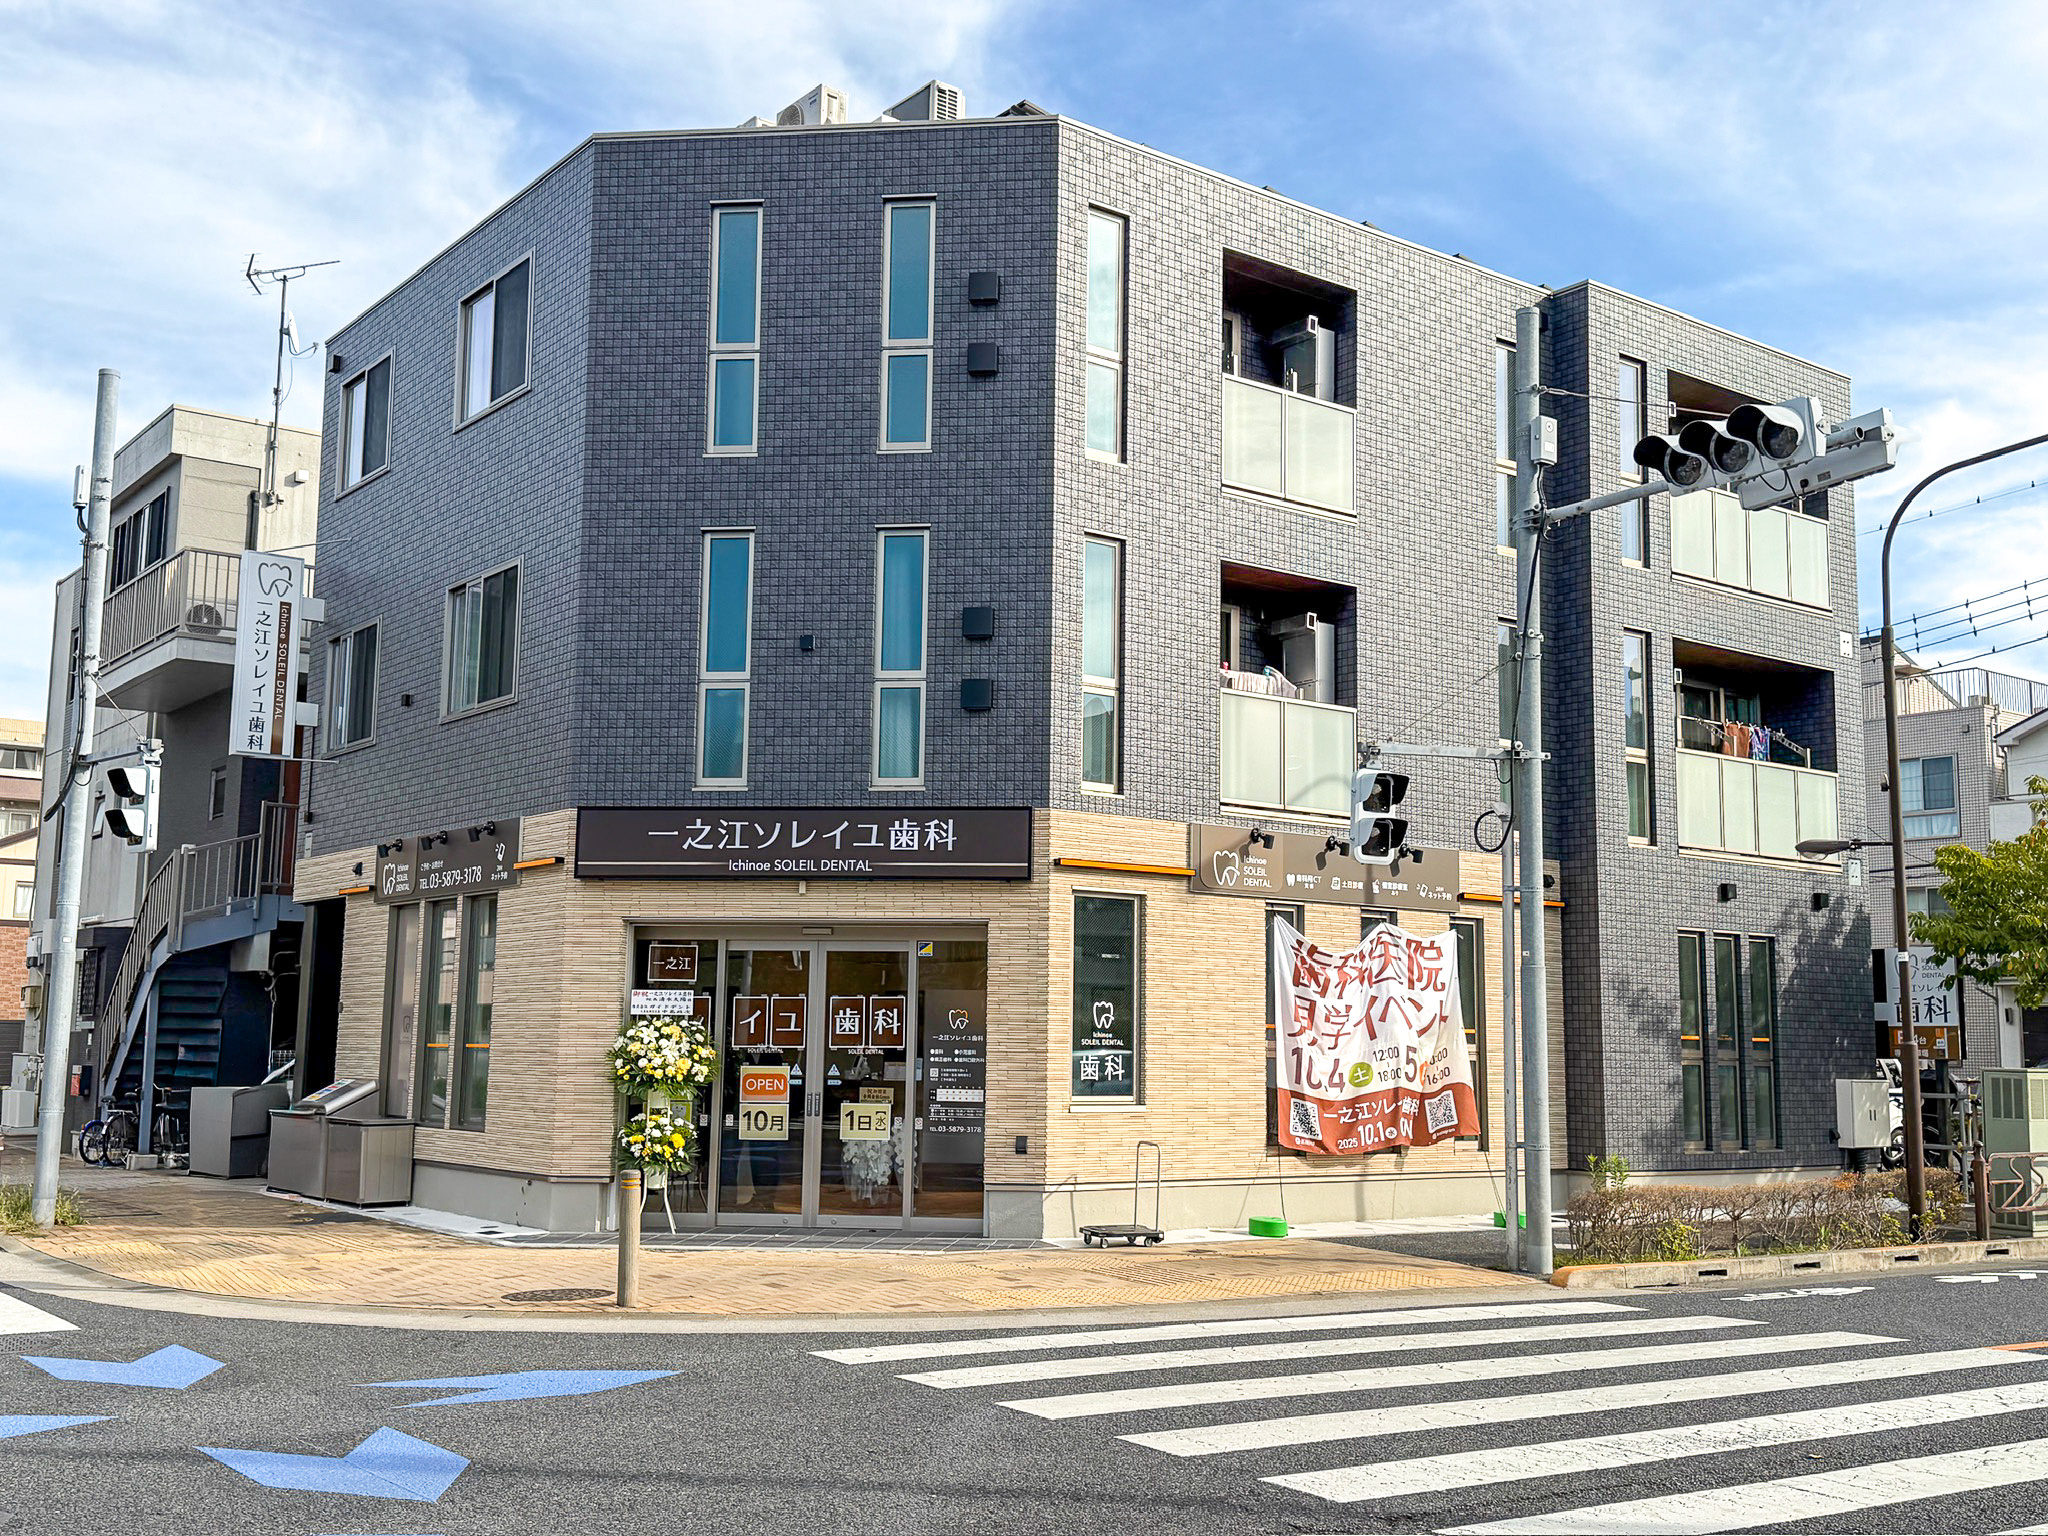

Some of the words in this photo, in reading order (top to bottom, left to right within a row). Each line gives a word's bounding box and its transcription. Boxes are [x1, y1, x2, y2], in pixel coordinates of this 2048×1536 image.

[280, 605, 290, 639] Ichinoe
[277, 643, 287, 677] SOLEIL
[247, 601, 273, 750] 一之江ソレイユ歯科
[274, 681, 285, 719] DENTAL
[648, 819, 957, 851] 一之江ソレイユ歯科
[729, 859, 771, 871] Ichinoe
[774, 860, 818, 871] SOLEIL
[821, 860, 873, 871] DENTAL
[1243, 855, 1267, 865] Ichinoe
[430, 865, 482, 889] 03-5879-3178
[1243, 866, 1268, 876] SOLEIL
[396, 883, 410, 892] DENTAL
[1243, 878, 1273, 888] DENTAL
[1427, 891, 1452, 901] ネット予約
[652, 956, 692, 970] 一之江
[1290, 931, 1446, 999] 歯科医院
[1287, 995, 1449, 1050] 見学イベント
[1373, 1046, 1400, 1062] 12:00
[1079, 1054, 1126, 1081] 歯科
[745, 1078, 785, 1091] OPEN
[742, 1110, 784, 1131] 10月
[938, 1125, 982, 1133] 03-5879-3178
[1338, 1138, 1358, 1149] 2025
[1358, 1121, 1385, 1147] 10.1
